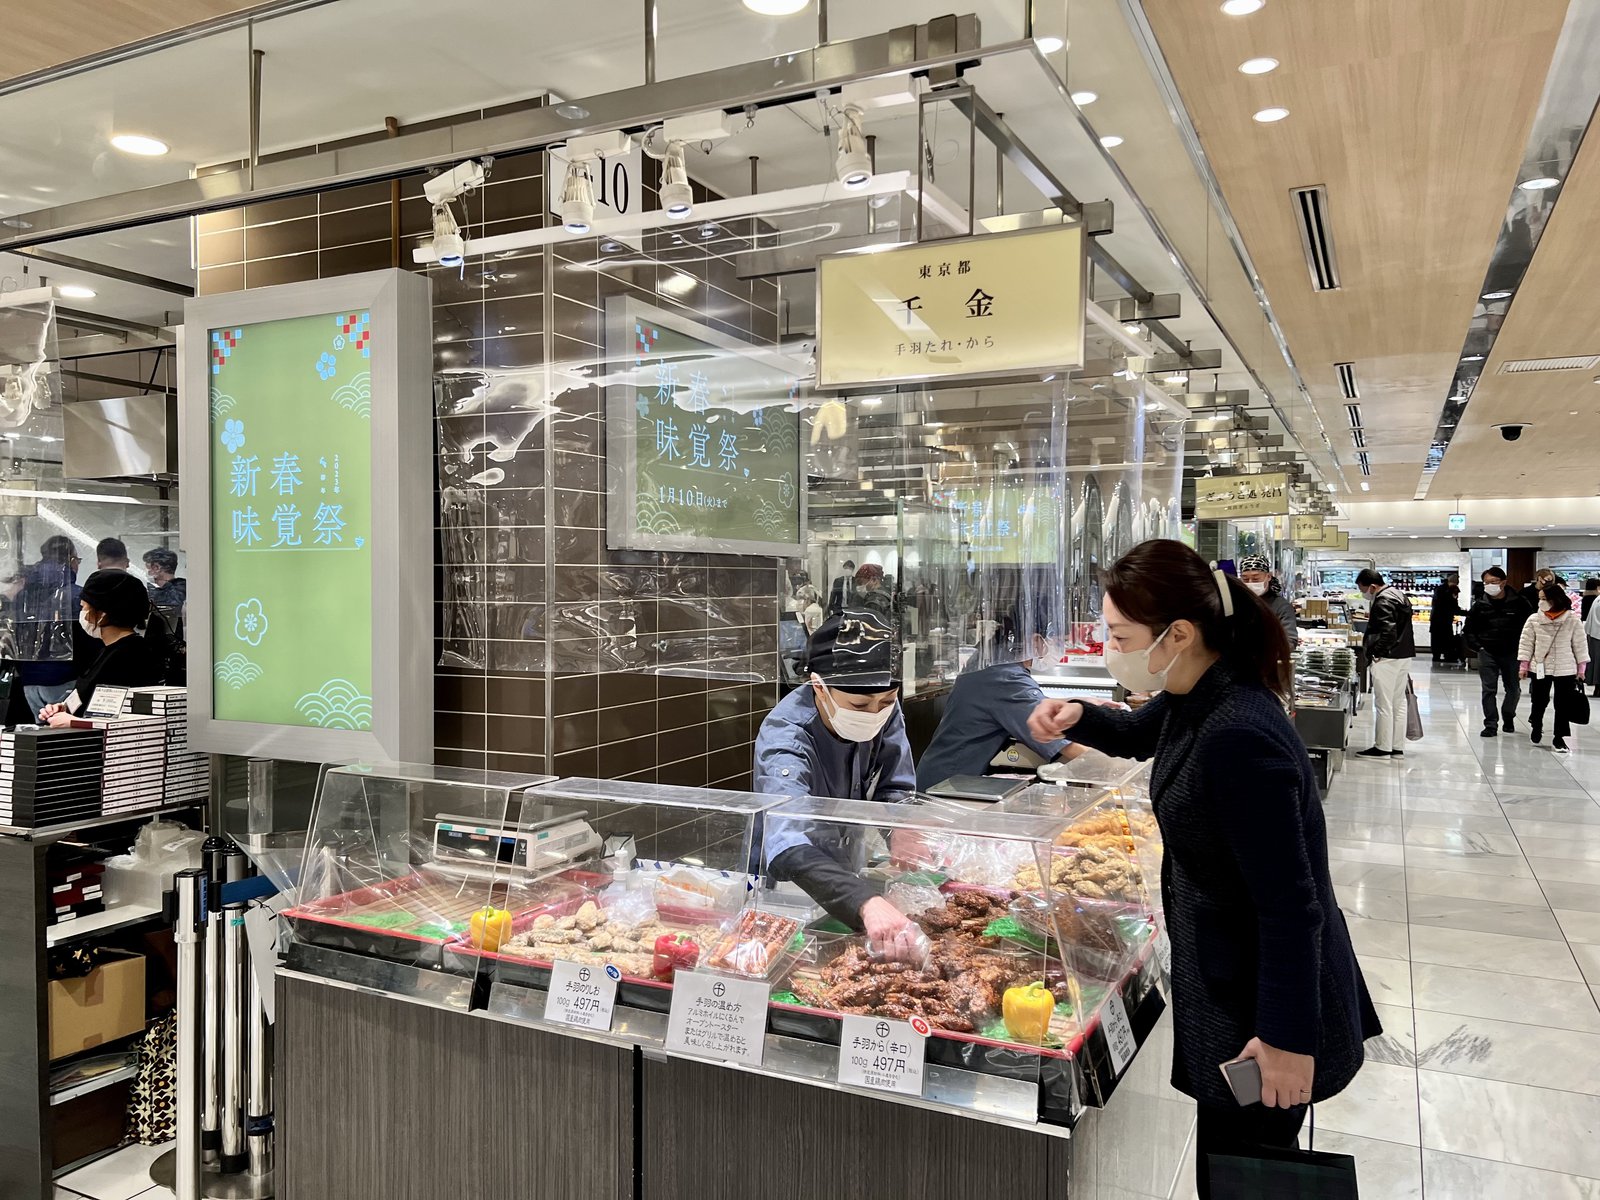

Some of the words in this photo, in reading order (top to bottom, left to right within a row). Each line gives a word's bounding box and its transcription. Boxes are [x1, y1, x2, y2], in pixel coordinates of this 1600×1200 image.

[919, 260, 971, 279] 東京都
[895, 335, 995, 356] 手羽たれ・から
[653, 358, 710, 415] 新春
[656, 417, 739, 471] 味覚祭
[230, 451, 303, 497] 新春
[659, 485, 728, 509] 1月10日(火)まで
[232, 502, 347, 547] 味覚祭
[556, 996, 571, 1008] 100g
[573, 996, 600, 1012] 497円
[695, 996, 742, 1012] 手羽の温め方
[687, 1007, 745, 1024] アルミホイルにくるんで
[684, 1026, 746, 1045] またはグリルで温めると
[852, 1036, 912, 1058] 手羽から(辛口)
[851, 1056, 868, 1068] 100g
[872, 1055, 906, 1074] 497円
